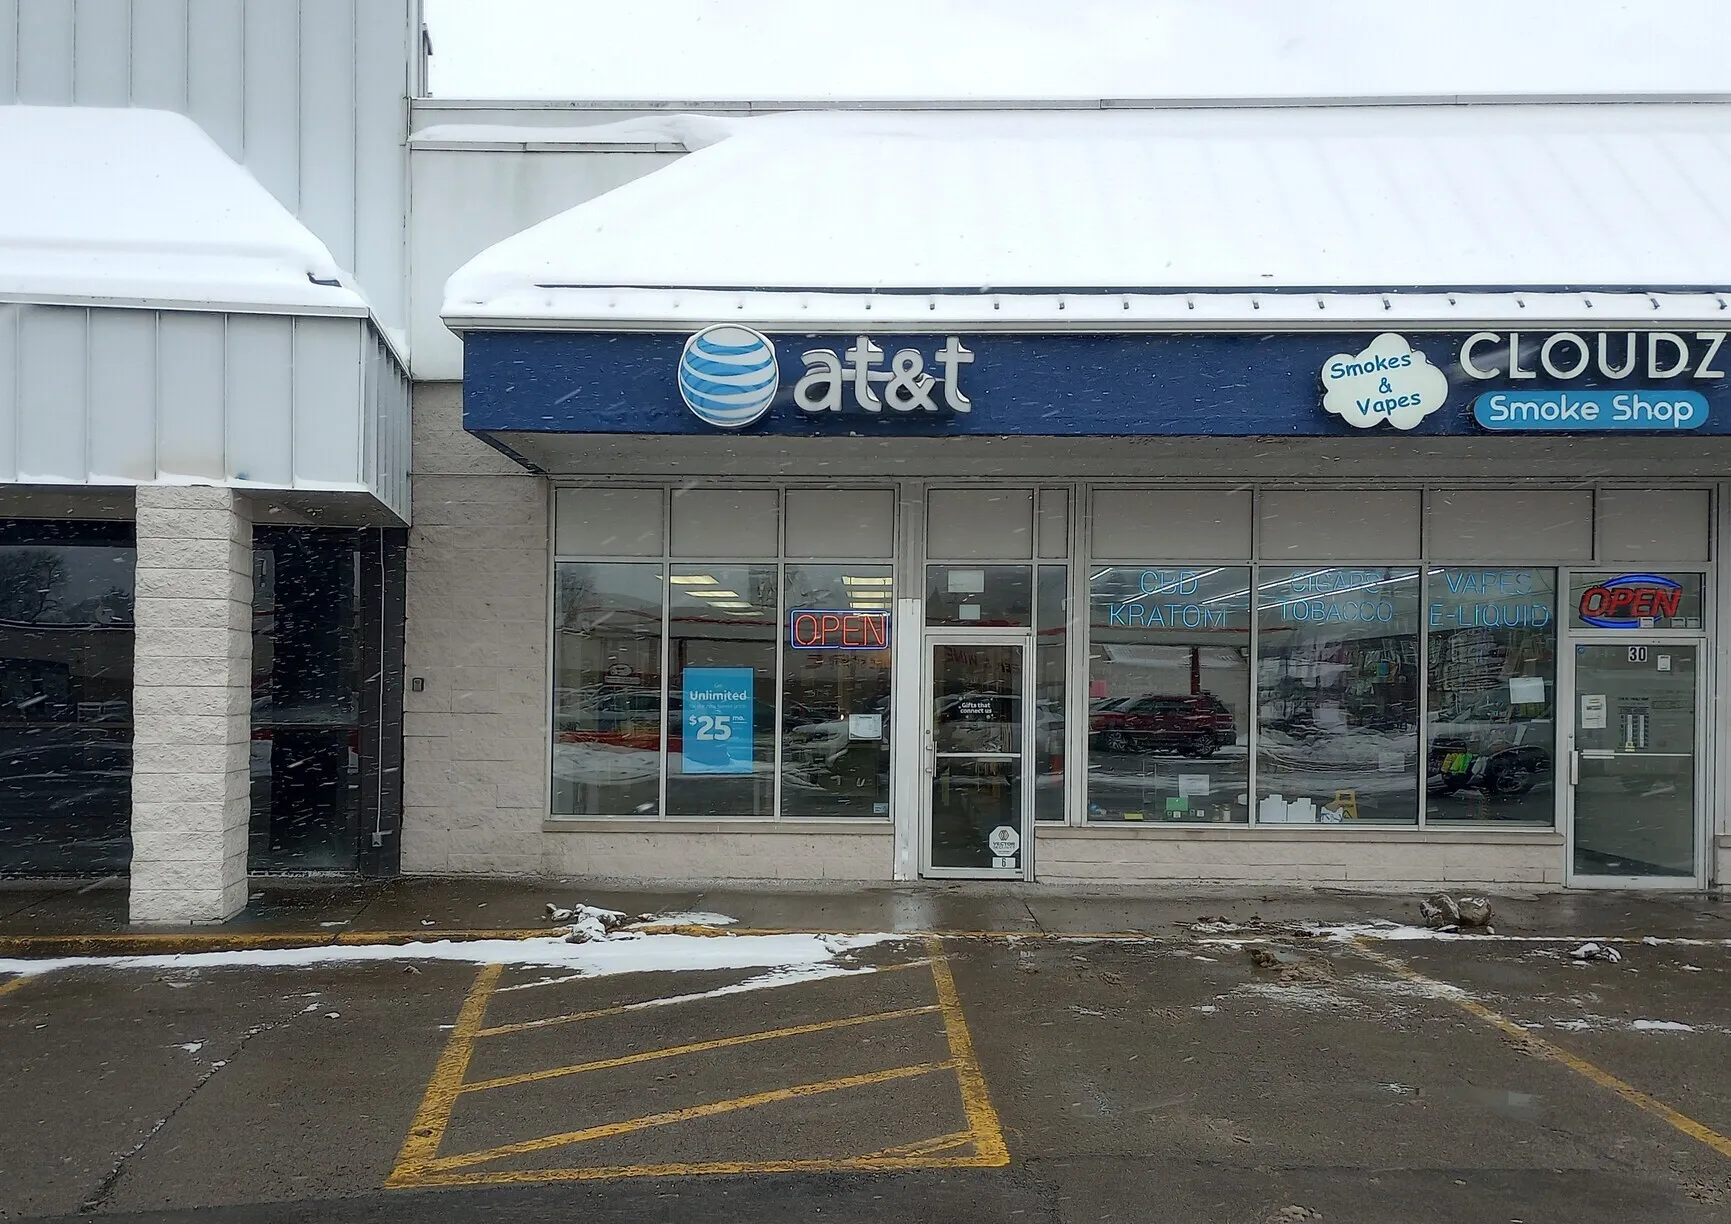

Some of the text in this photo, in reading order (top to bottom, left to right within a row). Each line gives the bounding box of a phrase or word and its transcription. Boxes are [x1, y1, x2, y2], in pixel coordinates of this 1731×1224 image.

[1331, 354, 1412, 380] Smokes
[1459, 332, 1725, 380] CLOUDZ
[793, 335, 975, 413] at&t
[1378, 377, 1393, 394] &
[1356, 393, 1422, 417] Vapes
[1489, 394, 1694, 428] Smoke Shop
[1139, 570, 1198, 596] CBD
[1444, 571, 1533, 596] VAPES
[1280, 600, 1394, 622] TOBACCO
[1579, 586, 1683, 618] OPEN
[1108, 603, 1227, 628] KRATOM
[1429, 603, 1551, 628] E-LIQUID
[795, 615, 886, 646] OPEN
[1629, 646, 1647, 662] 30
[689, 689, 747, 701] Unlimited
[689, 714, 732, 741] $25
[1001, 858, 1007, 867] 6
